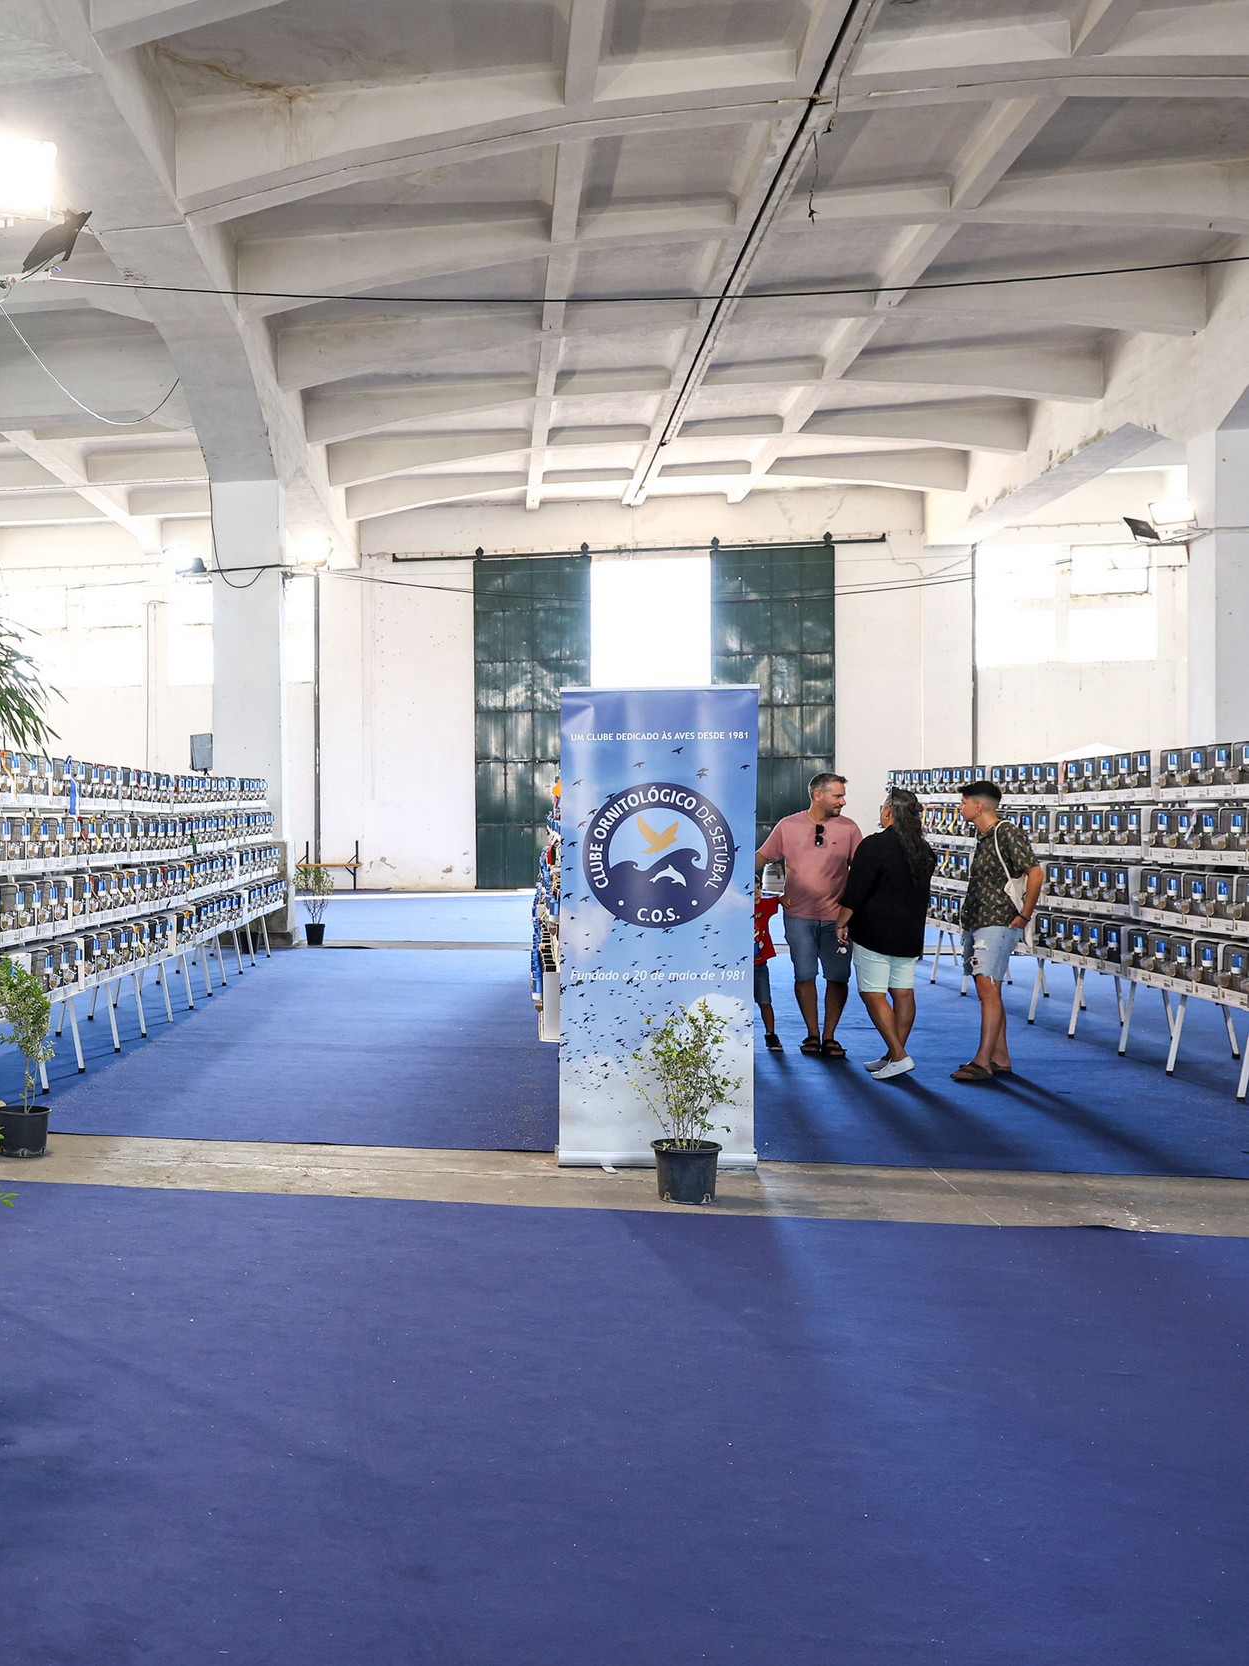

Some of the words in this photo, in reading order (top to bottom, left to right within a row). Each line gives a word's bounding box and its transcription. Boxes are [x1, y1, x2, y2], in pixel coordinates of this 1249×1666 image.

[570, 733, 584, 741] UM
[586, 732, 614, 741] CLUBE
[616, 732, 659, 740] DEDICADO
[661, 730, 673, 740] ÀS
[674, 731, 695, 740] AVES
[697, 731, 725, 740] DESDE
[728, 731, 749, 739] 1981
[593, 786, 697, 840] ORNITOLÓGICO
[695, 805, 717, 827] DE
[589, 842, 609, 889] CLUBE
[704, 826, 731, 889] SETÚBAL
[636, 907, 681, 923] C.O.S.
[570, 969, 619, 980] Fundado
[622, 971, 630, 980] a
[632, 969, 648, 980] 20
[650, 969, 665, 980] de
[668, 969, 697, 980] maio
[700, 970, 716, 980] de
[720, 970, 746, 980] 1981
